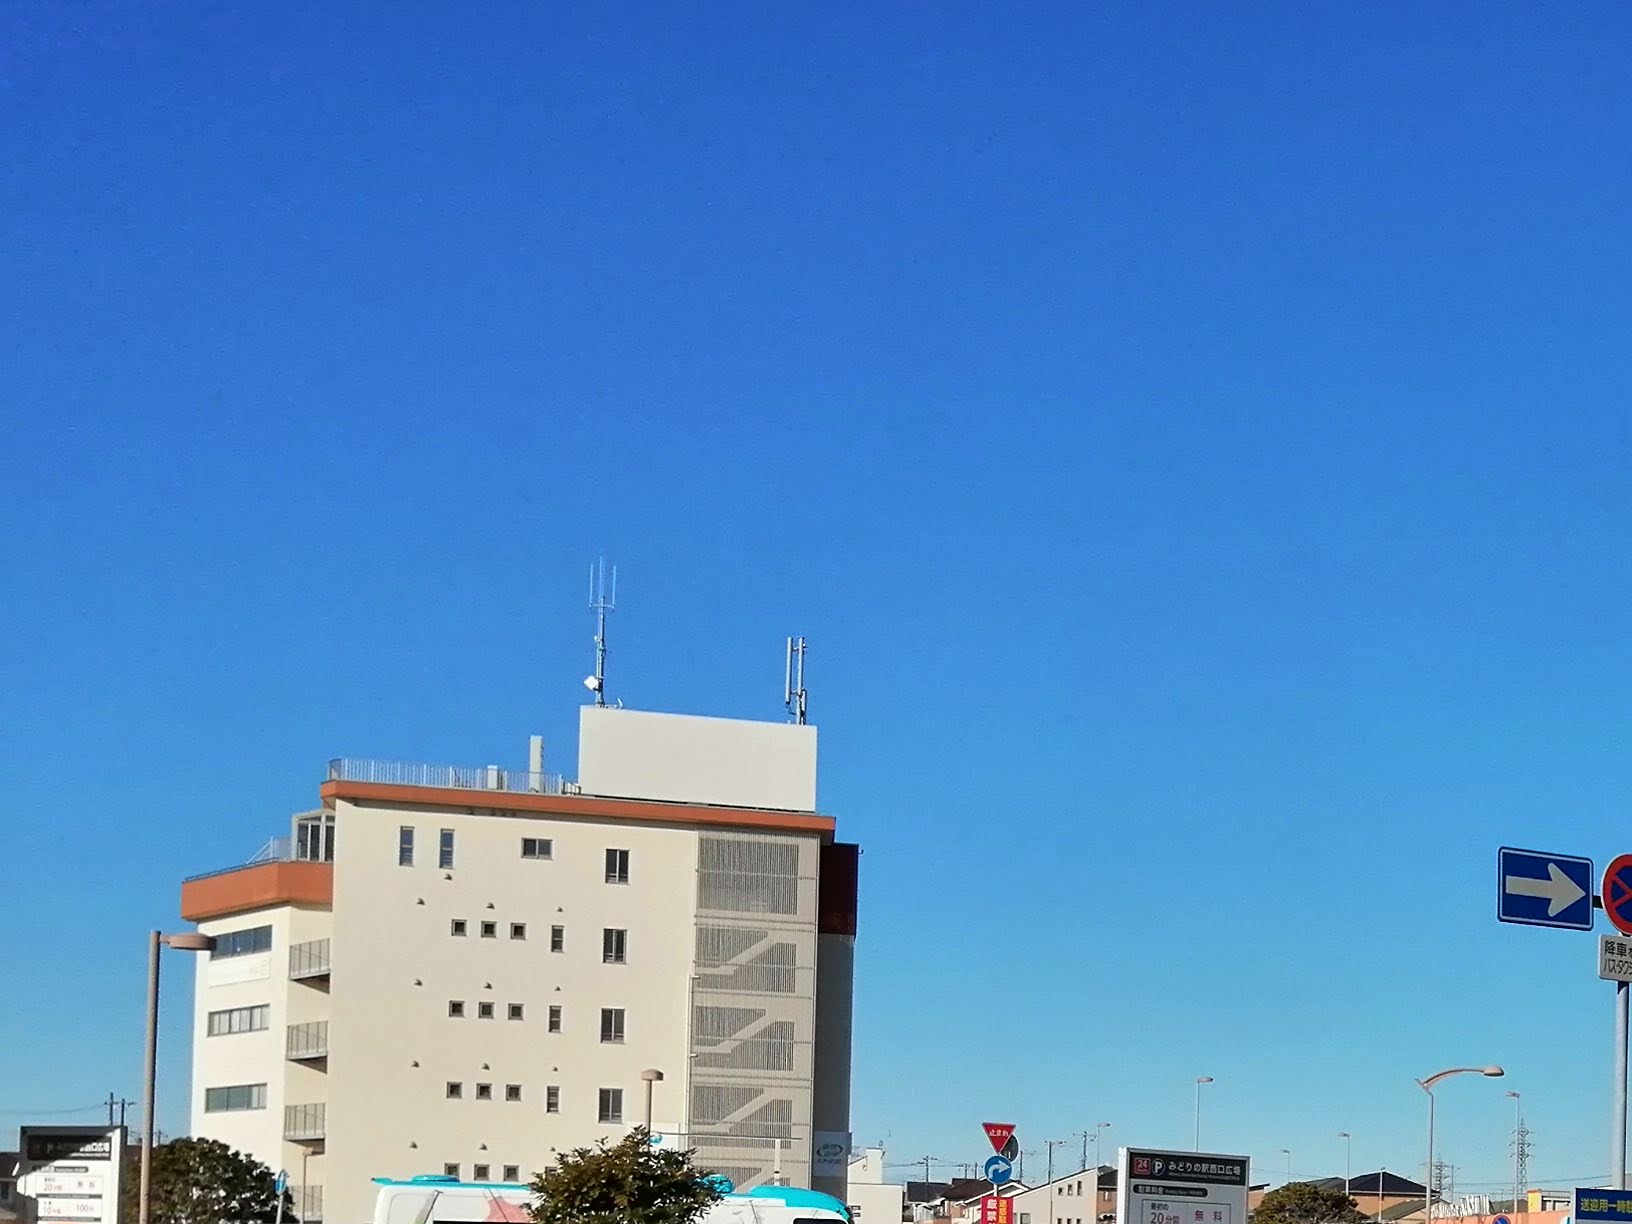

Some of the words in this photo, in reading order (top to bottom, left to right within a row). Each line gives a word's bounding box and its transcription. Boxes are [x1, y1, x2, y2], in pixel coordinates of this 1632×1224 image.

[989, 1129, 1008, 1137] 止まれ
[1168, 1161, 1241, 1176] みどりの駅西口広場
